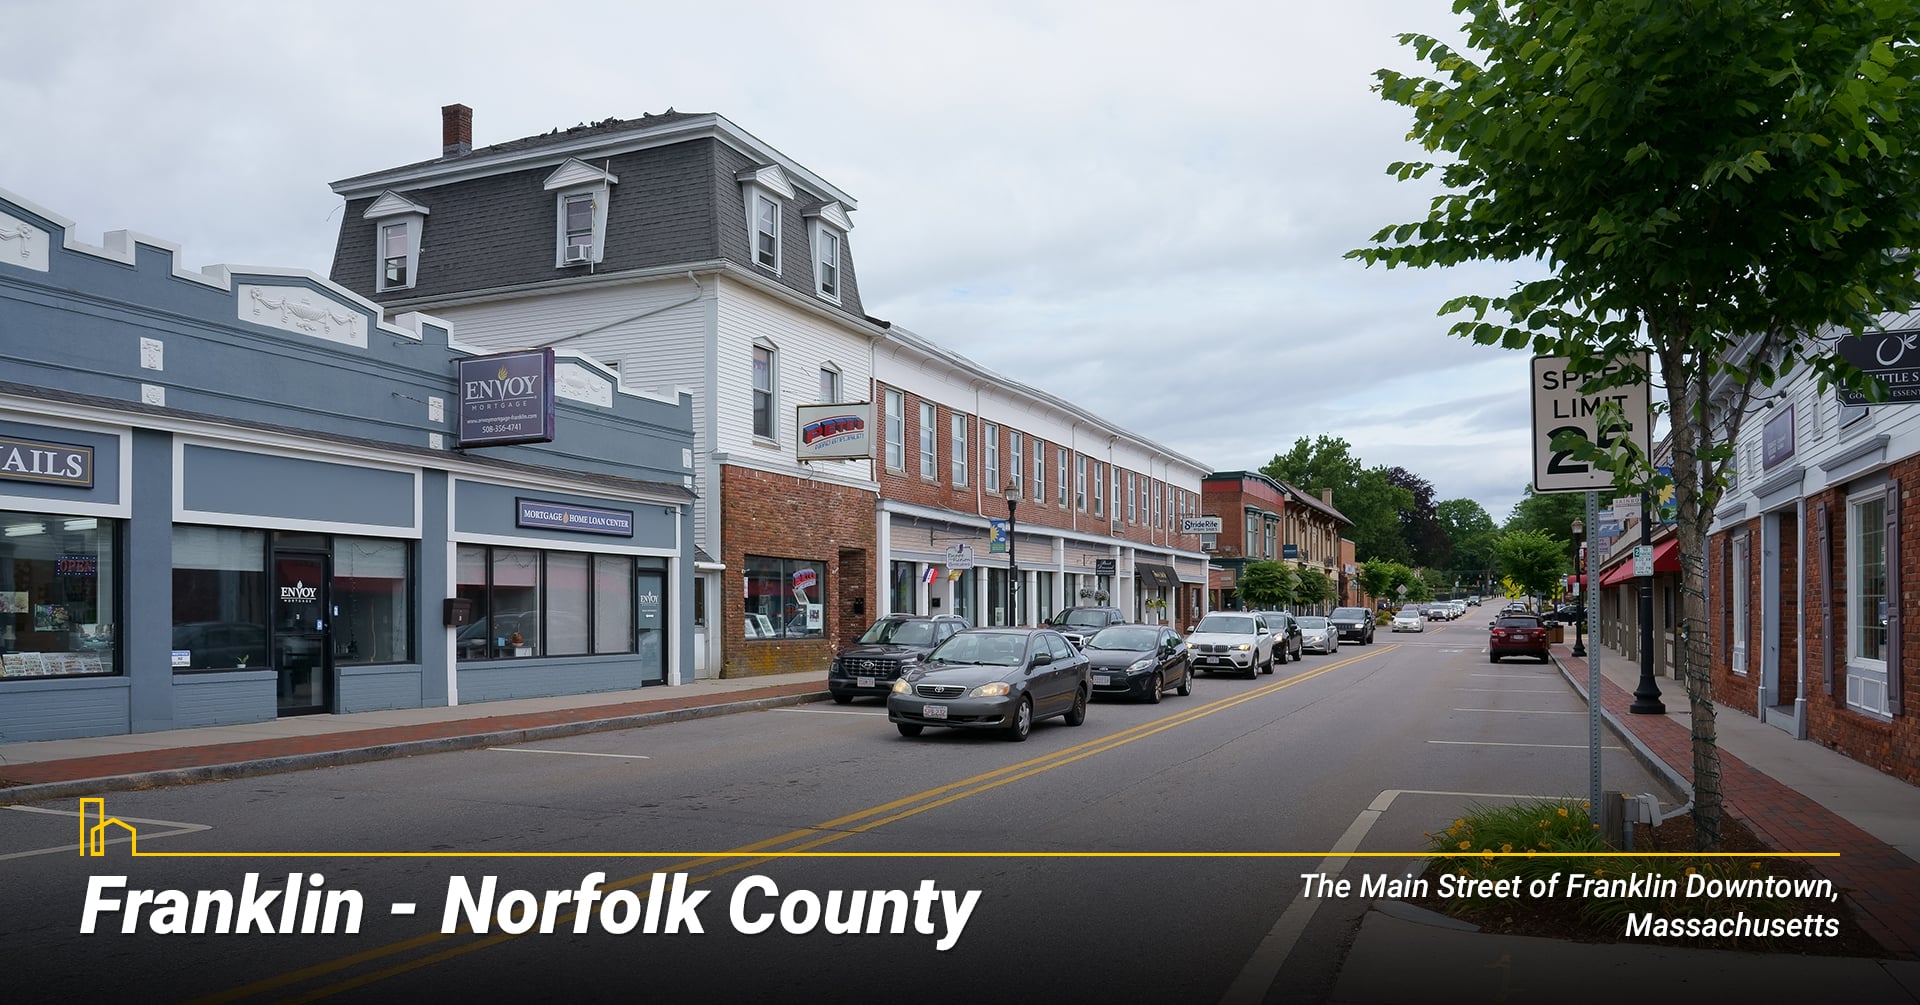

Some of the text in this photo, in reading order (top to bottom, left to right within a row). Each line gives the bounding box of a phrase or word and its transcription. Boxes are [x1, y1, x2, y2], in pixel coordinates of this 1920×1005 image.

[465, 375, 538, 401] ENVOY
[471, 400, 528, 411] MORTGAGE
[1553, 395, 1628, 419] LIMT
[482, 423, 522, 433] 508-356-4741
[0, 446, 83, 478] AILS
[523, 509, 629, 528] MORTGAGE HOME LOAN CENTER
[280, 586, 317, 598] ENVOY
[640, 595, 658, 603] ENVOY
